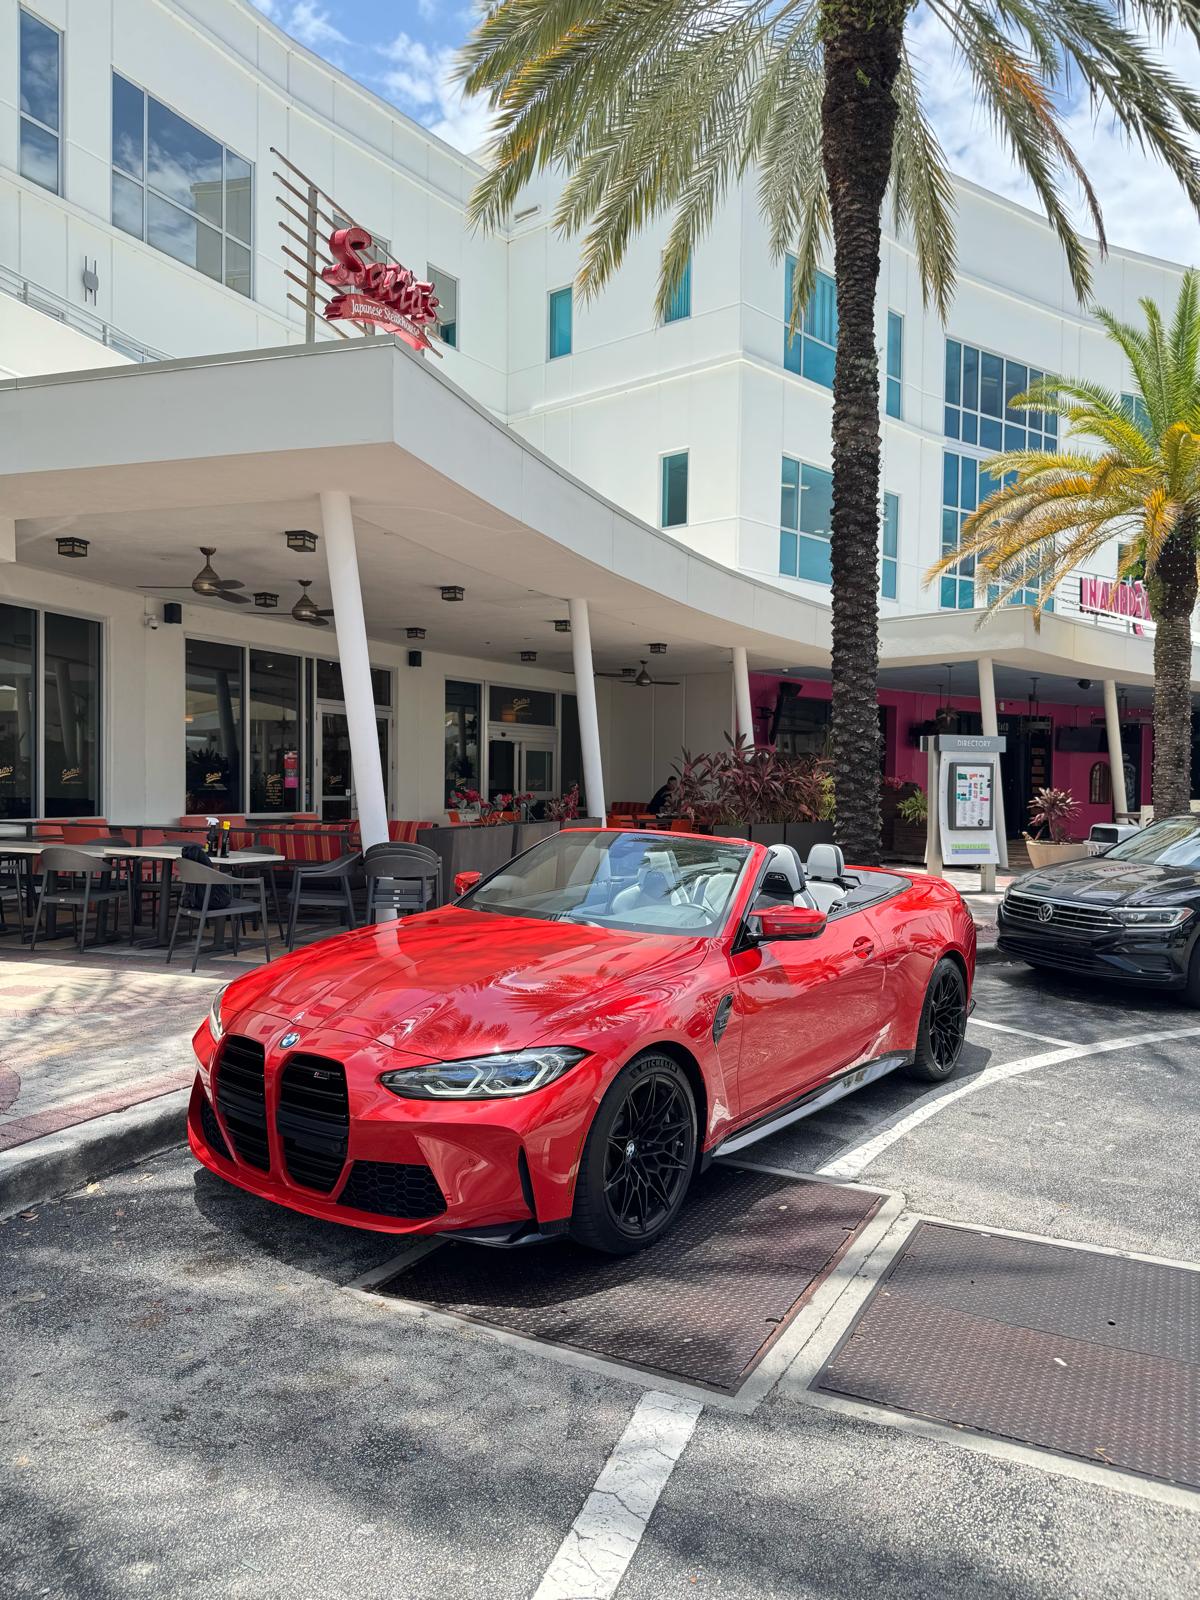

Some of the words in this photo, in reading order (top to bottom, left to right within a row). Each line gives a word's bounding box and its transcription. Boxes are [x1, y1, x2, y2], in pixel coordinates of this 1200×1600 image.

[351, 299, 383, 318] Japanese
[383, 307, 420, 338] Steakhouse
[1080, 576, 1136, 617] NAKED
[957, 739, 991, 747] DIRECTORY
